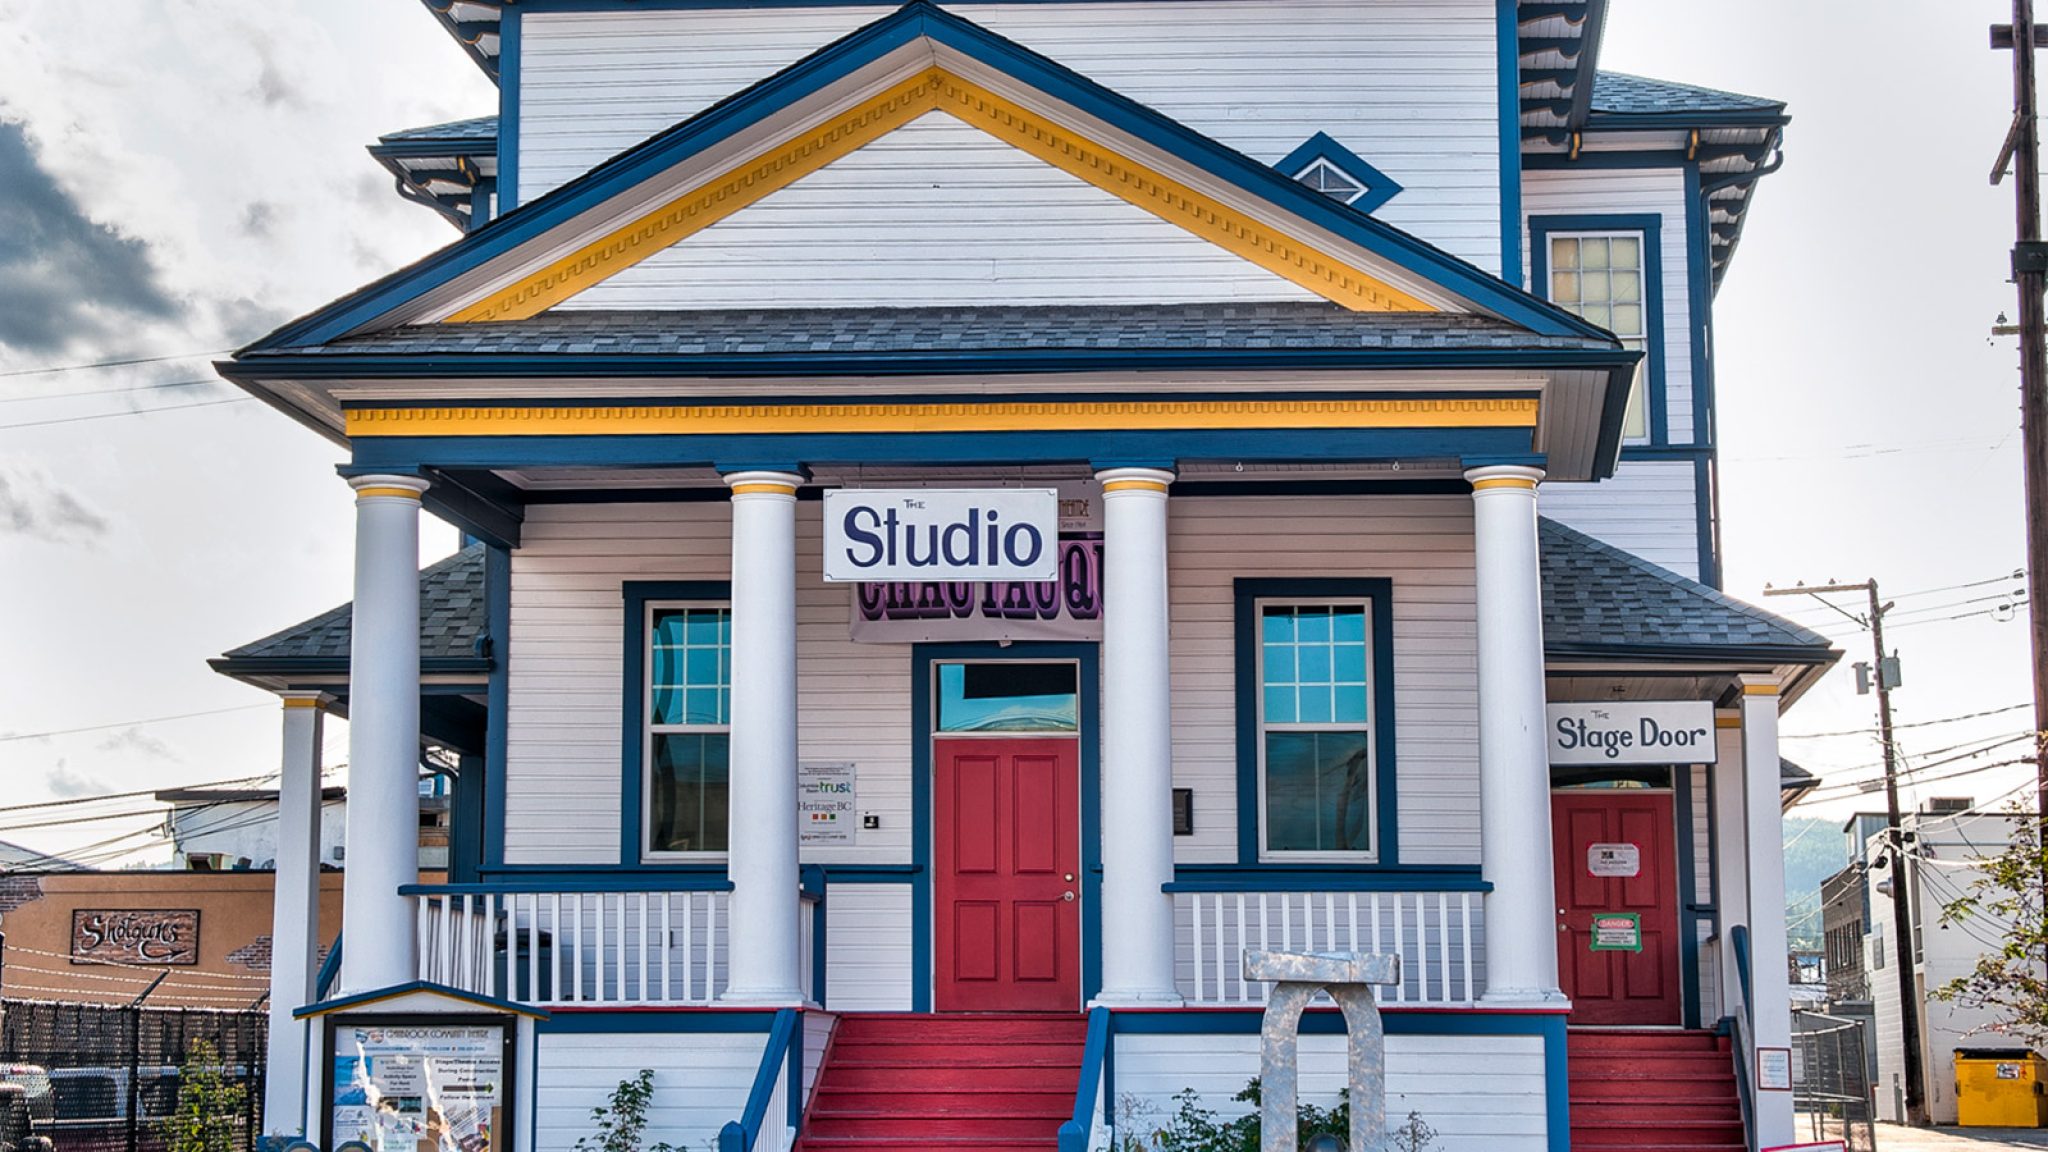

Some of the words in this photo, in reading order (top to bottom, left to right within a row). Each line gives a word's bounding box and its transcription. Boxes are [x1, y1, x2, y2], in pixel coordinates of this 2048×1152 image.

[903, 499, 926, 509] THE
[843, 506, 1043, 568] Studio
[1590, 710, 1610, 719] THE
[1556, 717, 1633, 758] Stage
[1639, 717, 1707, 747] Door
[819, 781, 851, 793] trust
[837, 801, 852, 811] BC
[79, 913, 180, 954] Shotguns
